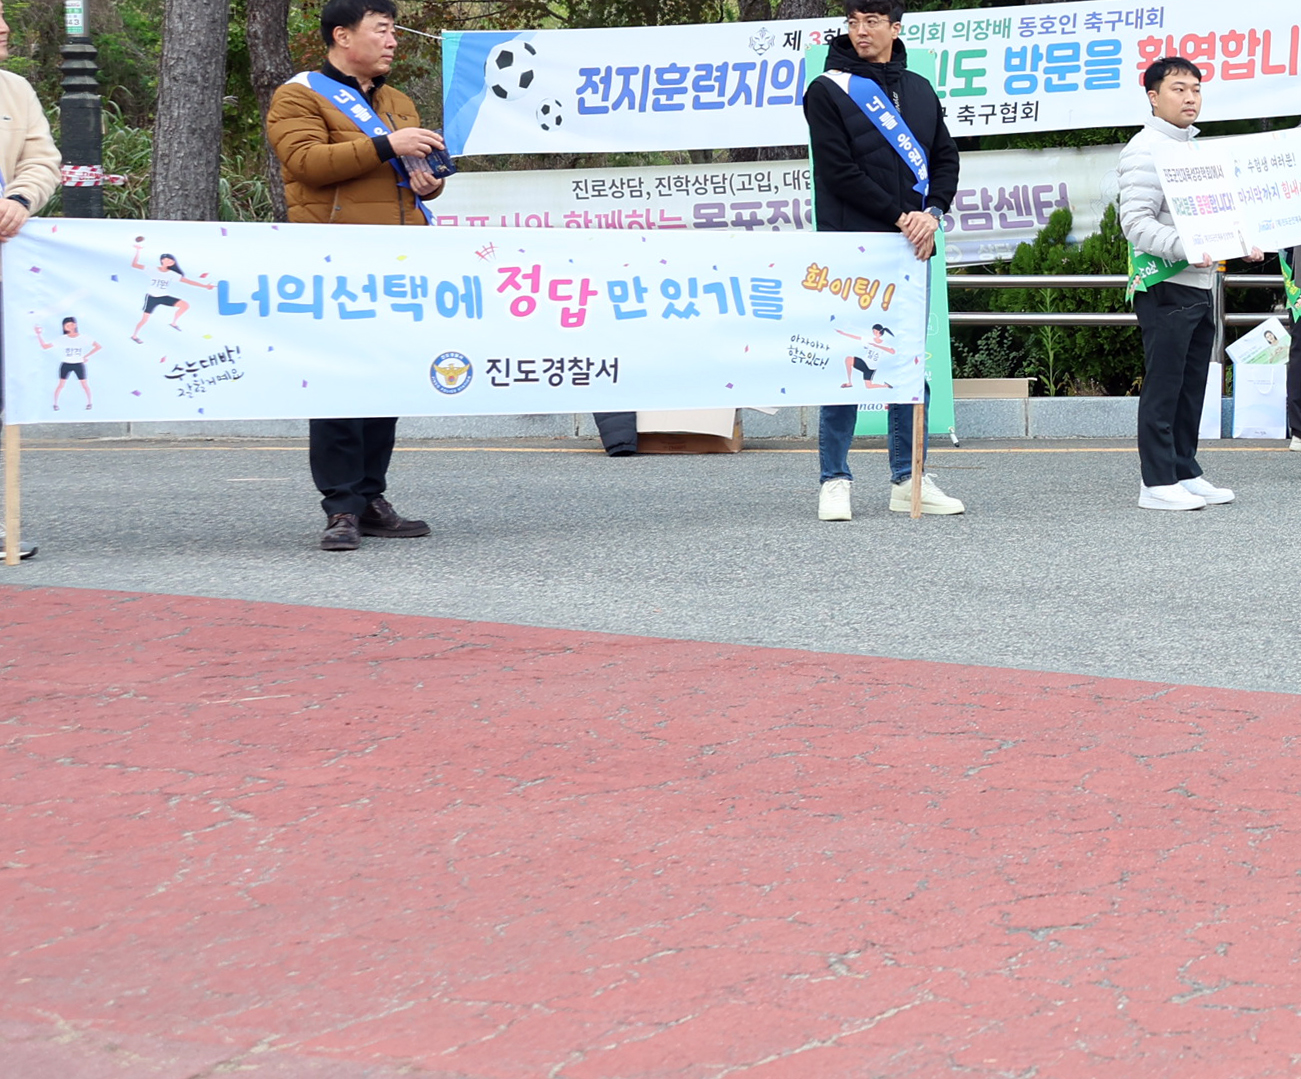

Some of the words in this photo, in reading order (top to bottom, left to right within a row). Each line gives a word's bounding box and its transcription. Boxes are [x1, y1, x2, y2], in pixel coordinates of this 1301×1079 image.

[782, 29, 802, 51] 제
[951, 17, 1012, 42] 의장배
[1017, 12, 1078, 38] 동호인
[1083, 6, 1165, 30] 축구대회
[1003, 38, 1122, 96] 방문을
[956, 100, 1040, 126] 축구협회
[571, 177, 652, 201] 진로상담,
[654, 170, 780, 198] 진학상담(고입,
[217, 272, 483, 322] 너의선택에
[660, 274, 784, 321] 있기를
[800, 262, 897, 312] 화이팅!
[485, 356, 620, 389] 진도경찰서
